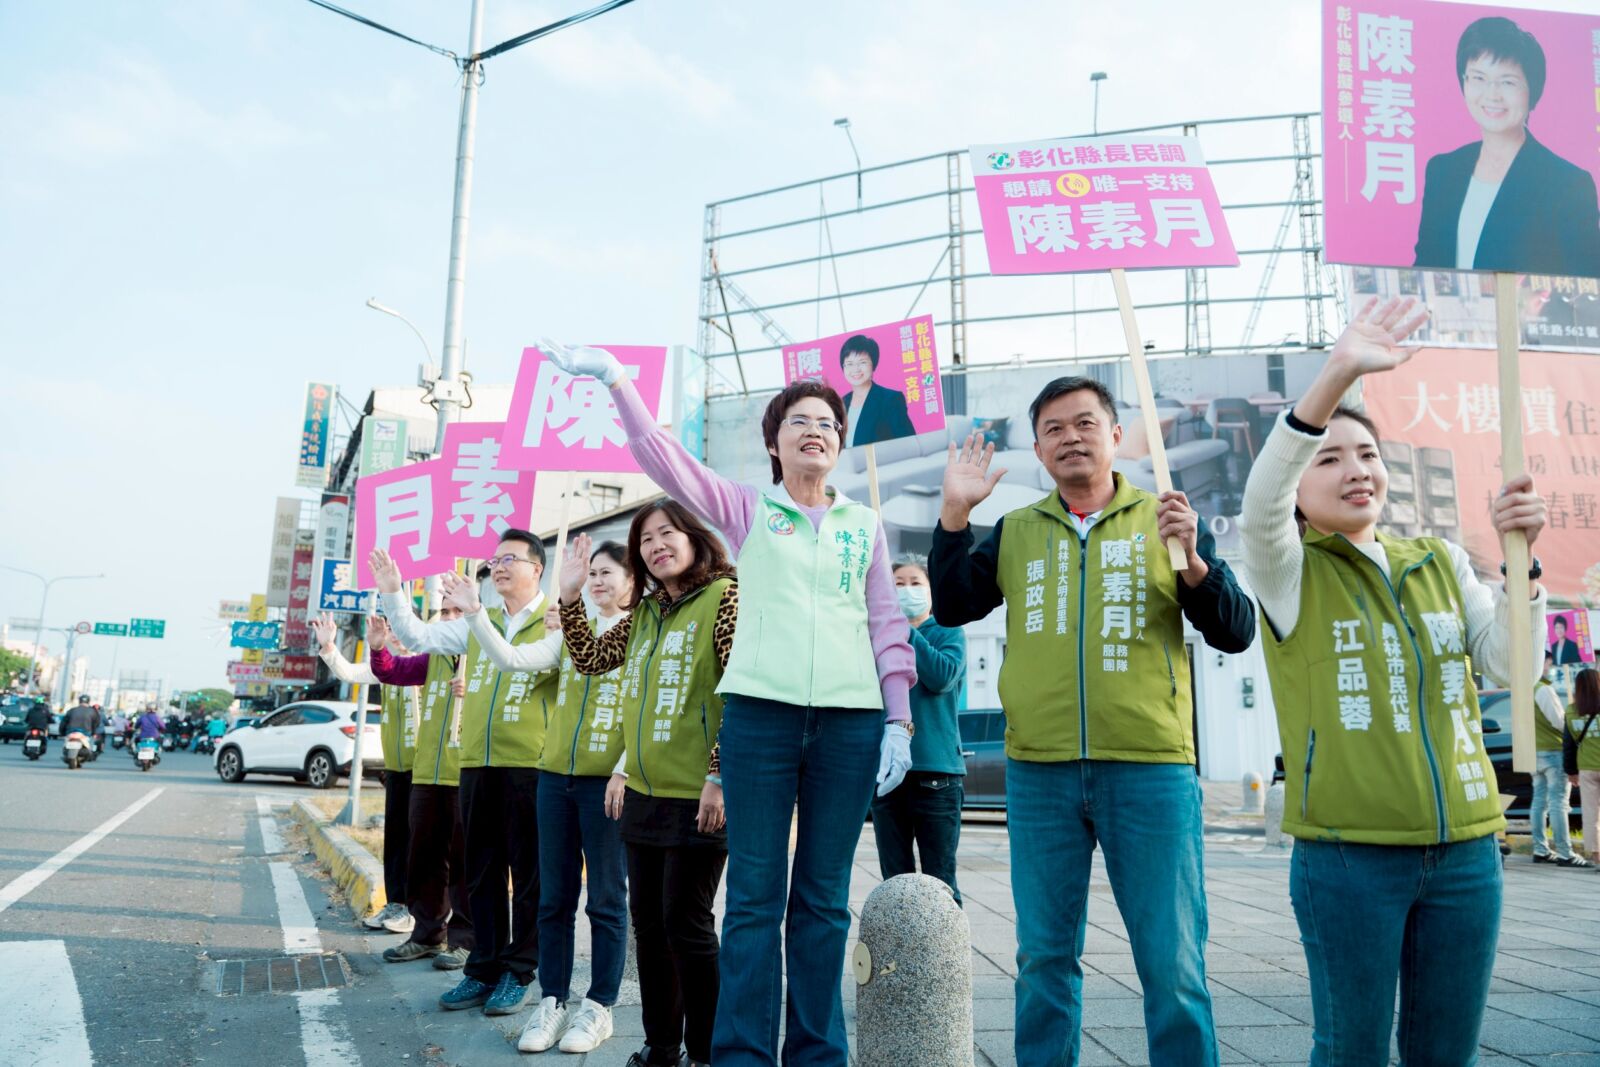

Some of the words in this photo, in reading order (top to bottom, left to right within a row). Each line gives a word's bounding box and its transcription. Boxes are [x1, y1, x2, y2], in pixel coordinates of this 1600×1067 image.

[1357, 12, 1417, 205] 陳素月
[1001, 178, 1053, 198] 懇請
[1091, 173, 1195, 194] 唯一支持
[1017, 144, 1187, 168] 彰化縣長民調
[1007, 198, 1215, 255] 陳素月
[899, 324, 921, 404] 懇請唯一支持
[915, 321, 934, 375] 彰化縣長
[521, 360, 640, 449] 陳
[375, 474, 433, 563] 月
[446, 437, 519, 538] 素
[835, 529, 857, 594] 陳素月
[1025, 559, 1046, 634] 張政岳
[1056, 539, 1069, 635] 員林市大明里里長
[1100, 538, 1133, 640] 陳素月
[654, 630, 686, 716] 陳素月
[1103, 644, 1128, 657] 服務
[1103, 658, 1129, 673] 團隊
[1332, 619, 1373, 732] 江品蓉
[1381, 621, 1412, 734] 員林市民代表
